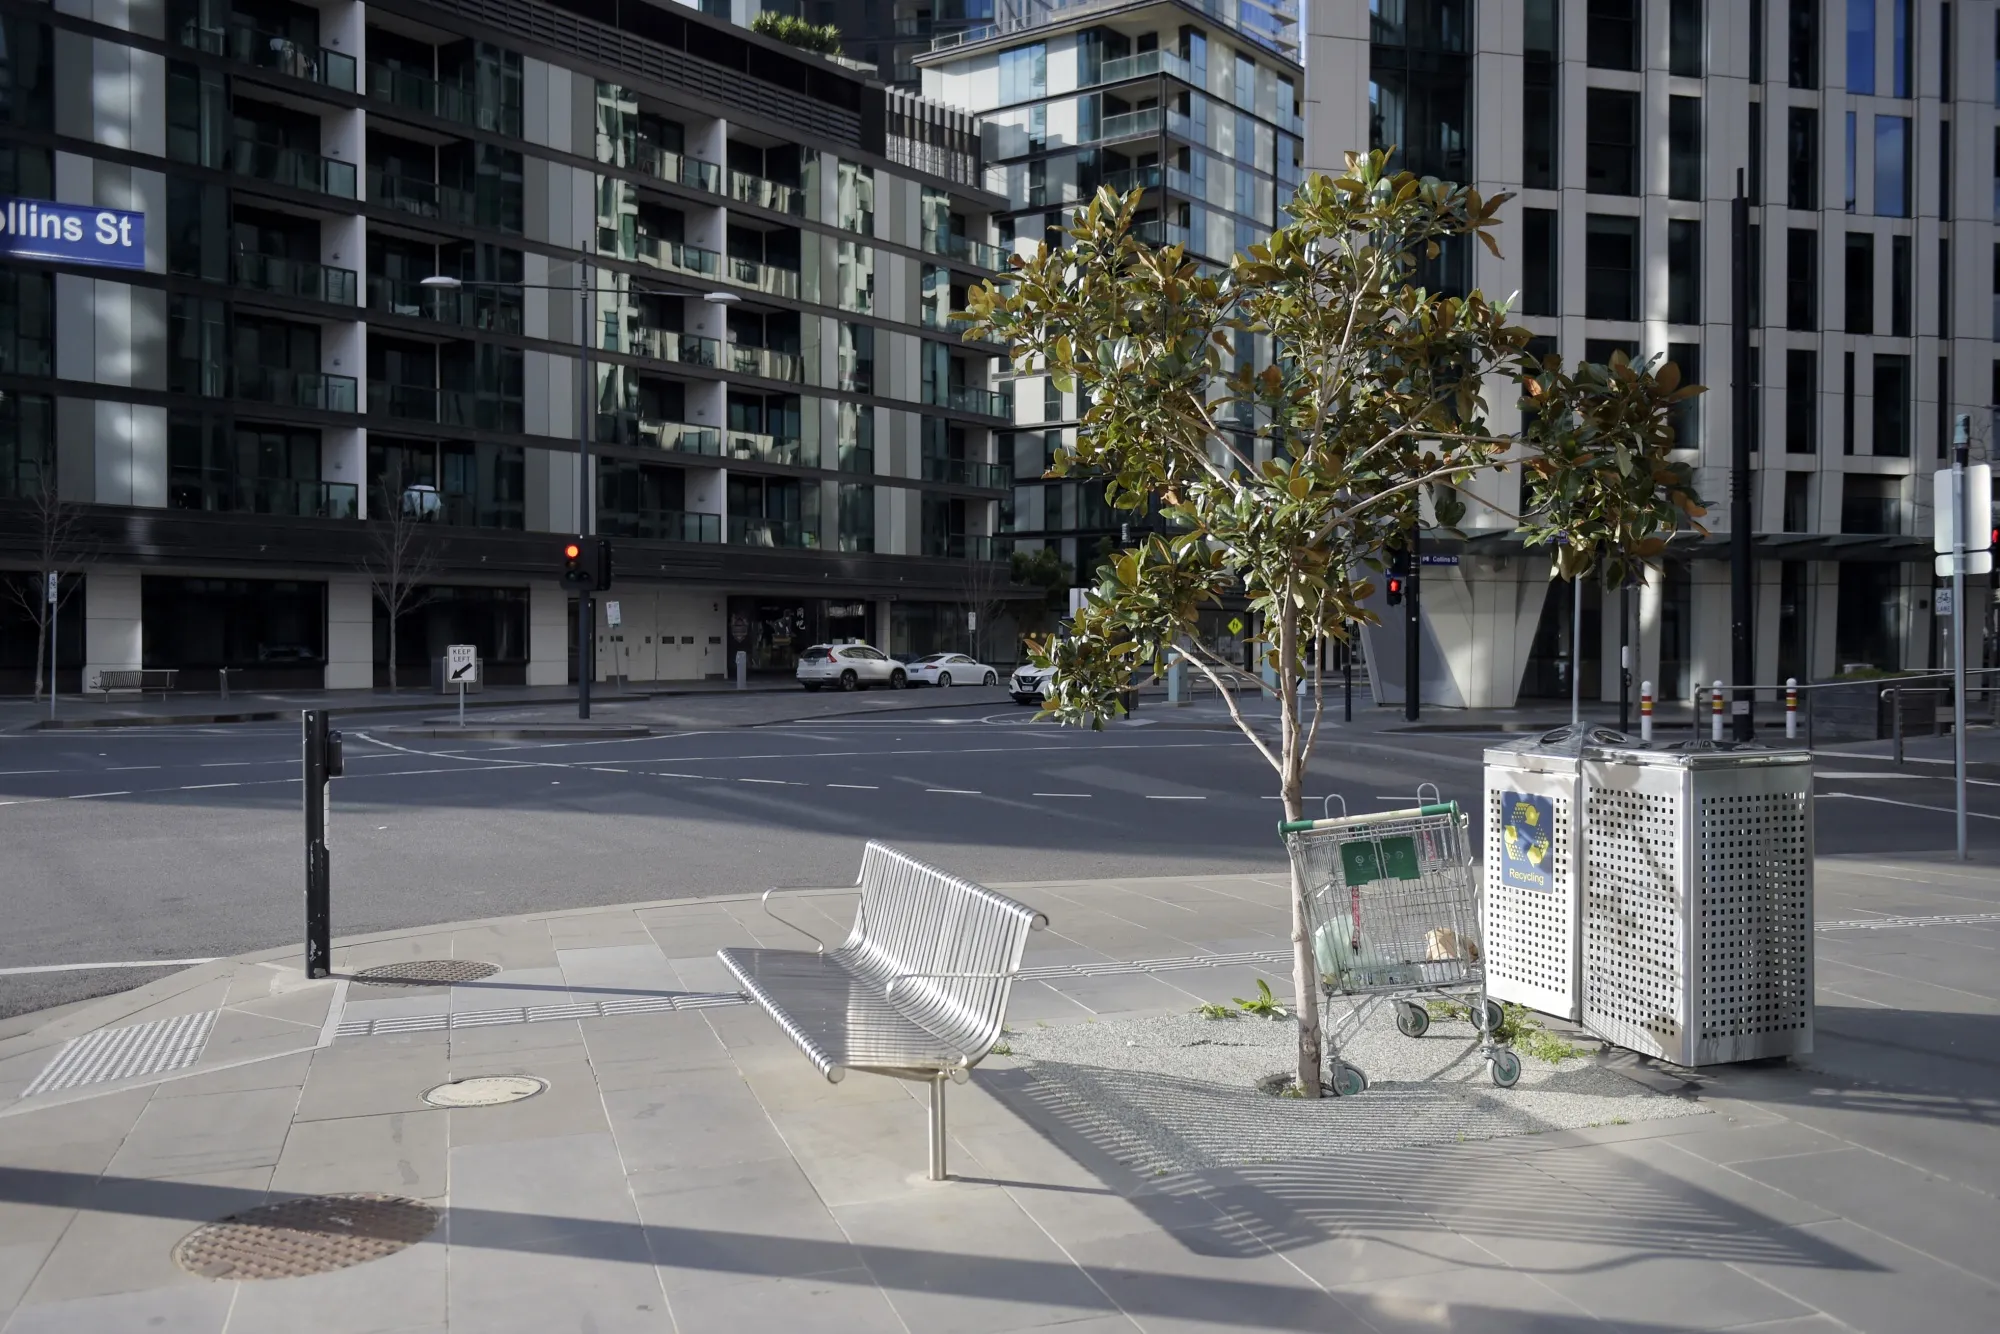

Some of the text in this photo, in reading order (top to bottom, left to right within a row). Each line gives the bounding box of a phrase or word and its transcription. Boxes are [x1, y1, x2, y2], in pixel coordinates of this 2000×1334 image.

[0, 202, 132, 247] llins St
[1509, 868, 1544, 885] Recycling
